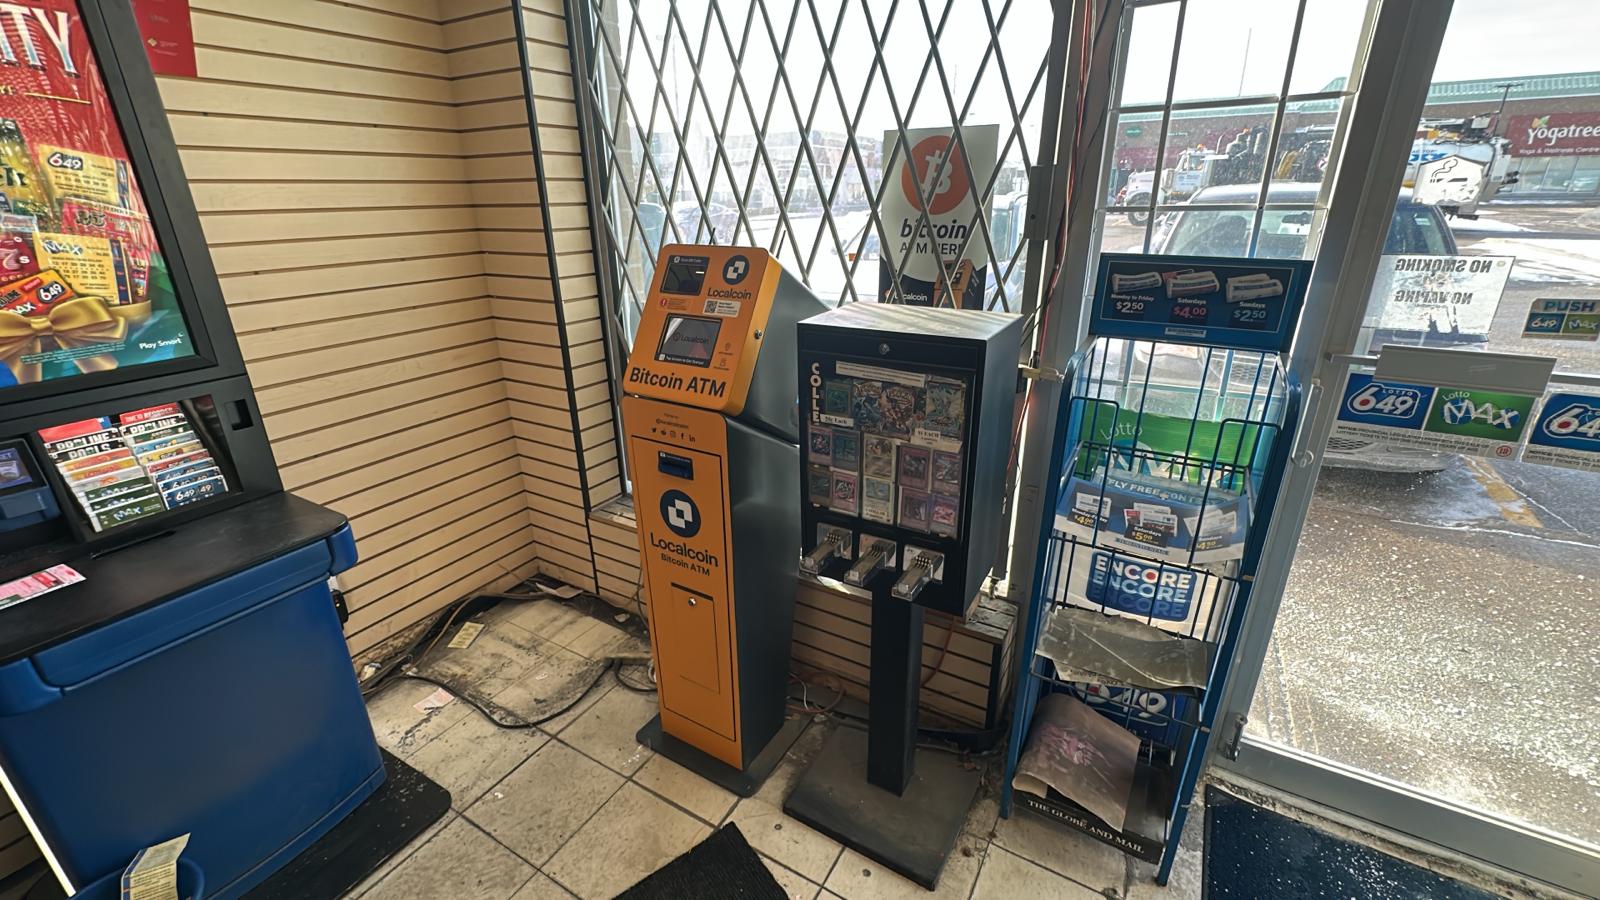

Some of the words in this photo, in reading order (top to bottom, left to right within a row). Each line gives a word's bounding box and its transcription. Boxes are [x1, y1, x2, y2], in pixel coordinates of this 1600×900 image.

[1527, 124, 1600, 146] yogatree
[48, 151, 83, 170] 649
[900, 217, 968, 239] btoin
[900, 242, 928, 255] AM
[39, 282, 63, 301] 649
[707, 287, 752, 300] Localcoin
[894, 292, 928, 302] Lcalcoin
[1177, 297, 1207, 305] Saturdays
[1543, 301, 1596, 312] PUSH
[1531, 317, 1557, 328] 649
[138, 342, 157, 350] Play
[157, 337, 182, 347] Smart
[629, 366, 684, 391] Bitcoin
[685, 376, 727, 398] ATM
[810, 362, 823, 425] COLLE
[1352, 386, 1413, 415] 649
[1382, 388, 1413, 397] LOTTO
[1442, 390, 1471, 401] Lotto
[1443, 399, 1520, 429] MAX
[1550, 407, 1600, 438] 64
[1100, 421, 1143, 440] Lotto
[175, 487, 196, 502] 649
[1109, 478, 1128, 490] FLY
[1129, 482, 1161, 495] FREE
[112, 505, 144, 522] MAX
[1134, 526, 1162, 537] Saturdays
[650, 531, 719, 568] Localcoin
[661, 552, 689, 571] Bitcoin
[689, 562, 710, 577] ATM
[1095, 554, 1193, 589] ENCORE
[1092, 569, 1188, 604] ENCORE
[1027, 799, 1051, 813] THE
[1051, 808, 1088, 830] GLOBE
[1088, 826, 1113, 840] AND
[1115, 836, 1145, 854] MAIL
